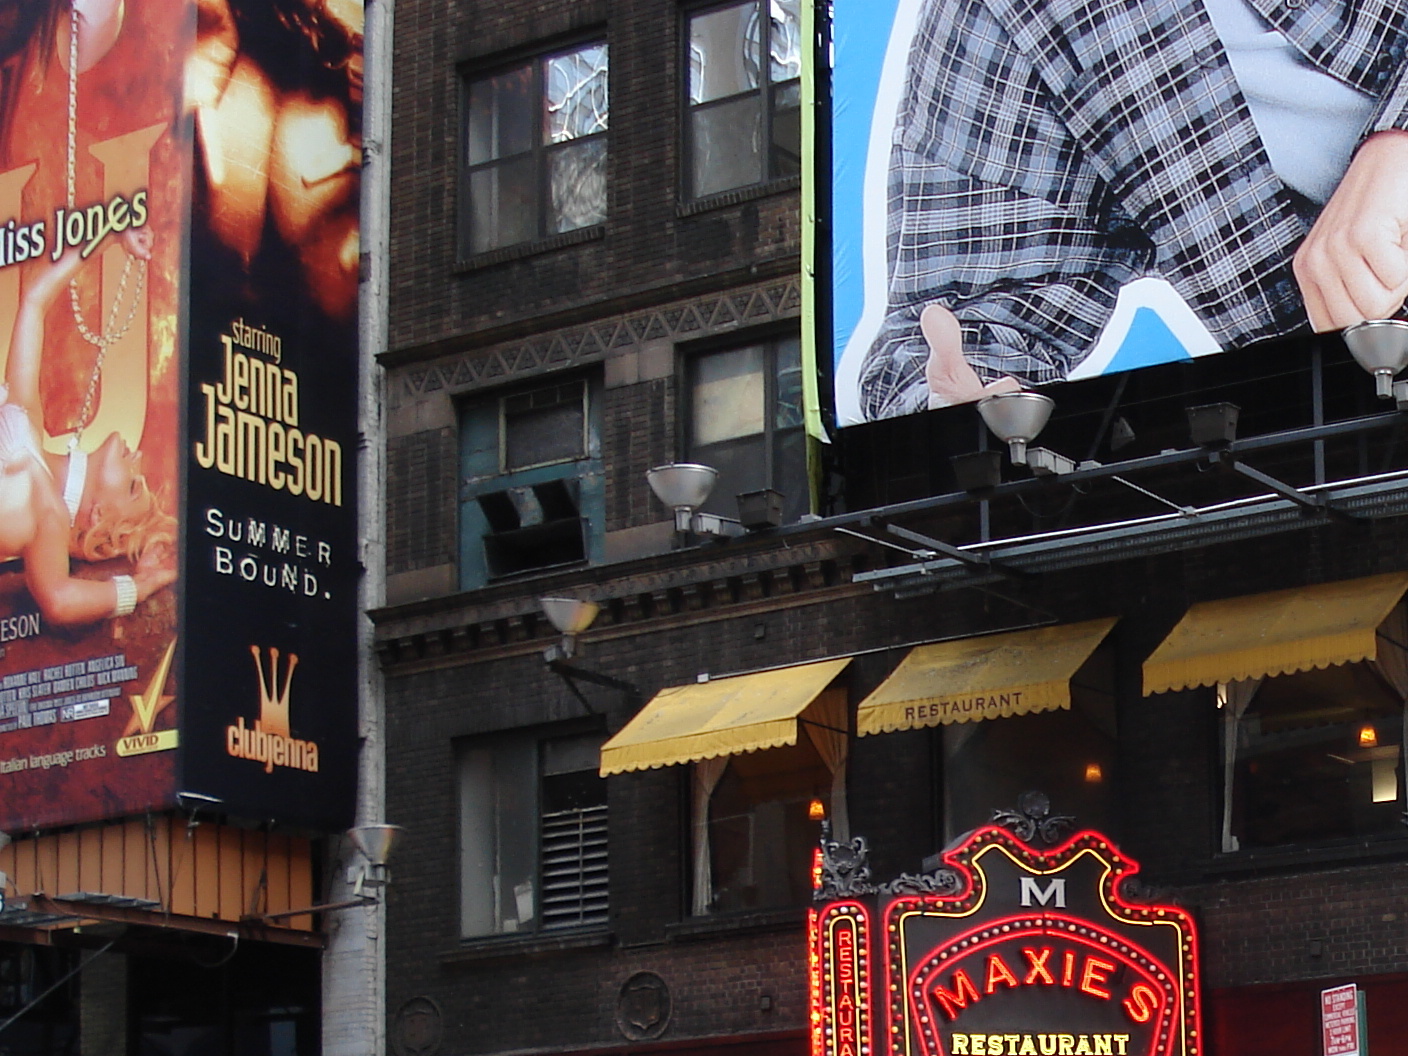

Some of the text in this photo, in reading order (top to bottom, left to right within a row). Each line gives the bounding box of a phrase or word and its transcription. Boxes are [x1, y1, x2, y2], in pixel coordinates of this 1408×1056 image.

[52, 191, 147, 261] Jones
[232, 316, 282, 364] starring
[217, 334, 299, 427] Jenna
[196, 383, 342, 507] Jameson
[905, 692, 1022, 721] RESTAURANT
[29, 750, 73, 769] language
[75, 744, 106, 760] tracks
[123, 734, 159, 750] VIVID
[227, 716, 319, 774] clubjenna
[1019, 877, 1066, 908] M
[951, 1033, 1130, 1056] RESTAURANT
